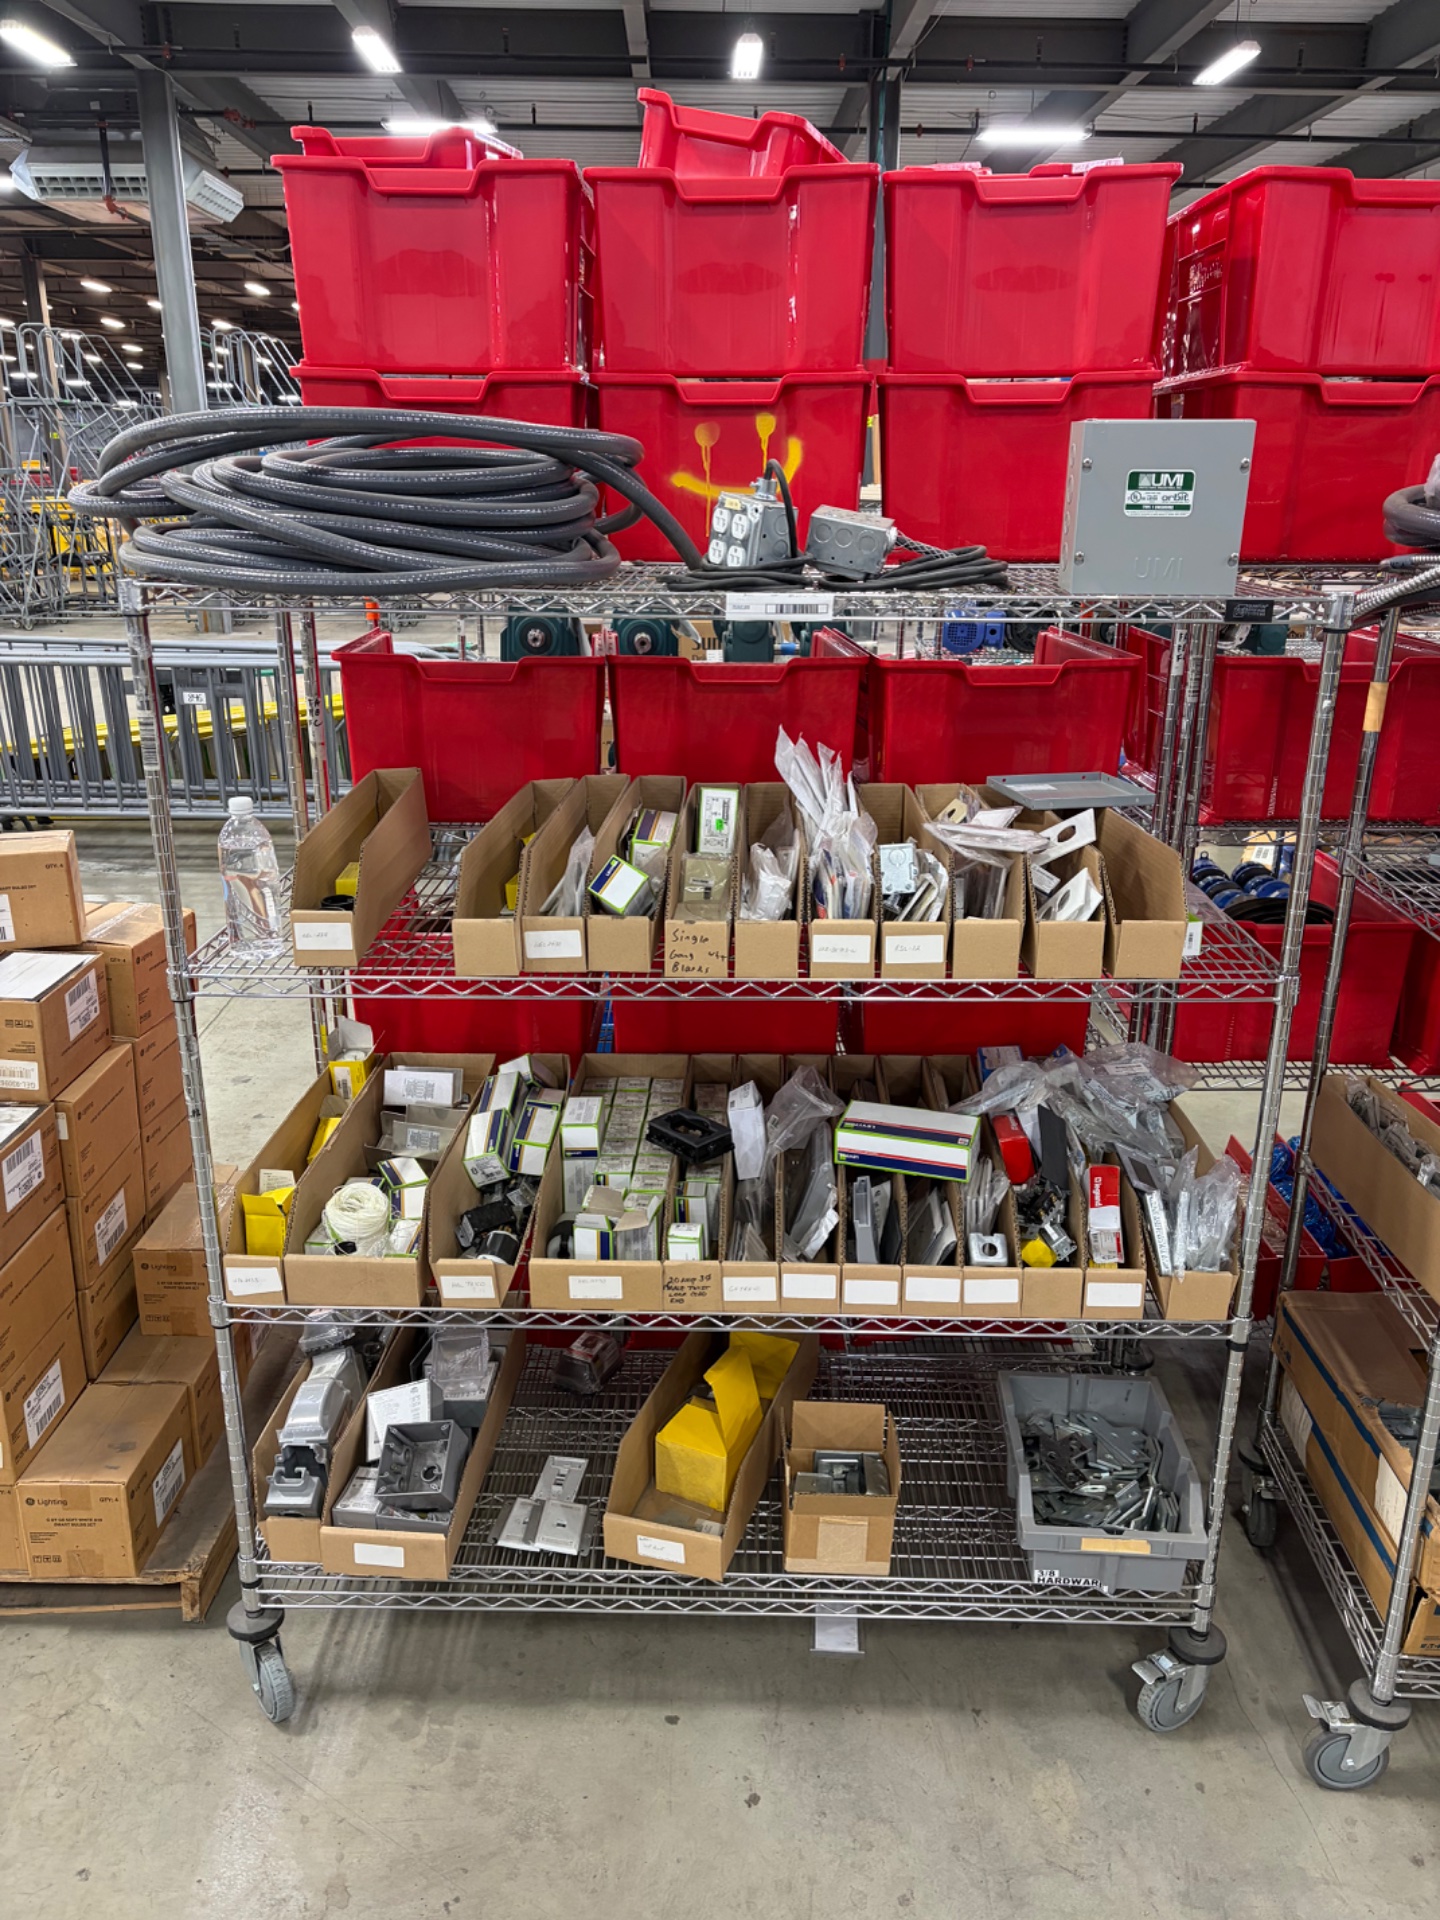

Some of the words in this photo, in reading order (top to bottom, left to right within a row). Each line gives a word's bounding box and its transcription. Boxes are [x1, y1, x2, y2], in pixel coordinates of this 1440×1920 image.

[1152, 473, 1184, 487] UMI
[1161, 492, 1189, 502] orbit
[1134, 556, 1183, 580] UMI
[671, 927, 710, 945] Single
[669, 949, 694, 961] Gang
[37, 1498, 68, 1506] Lighting
